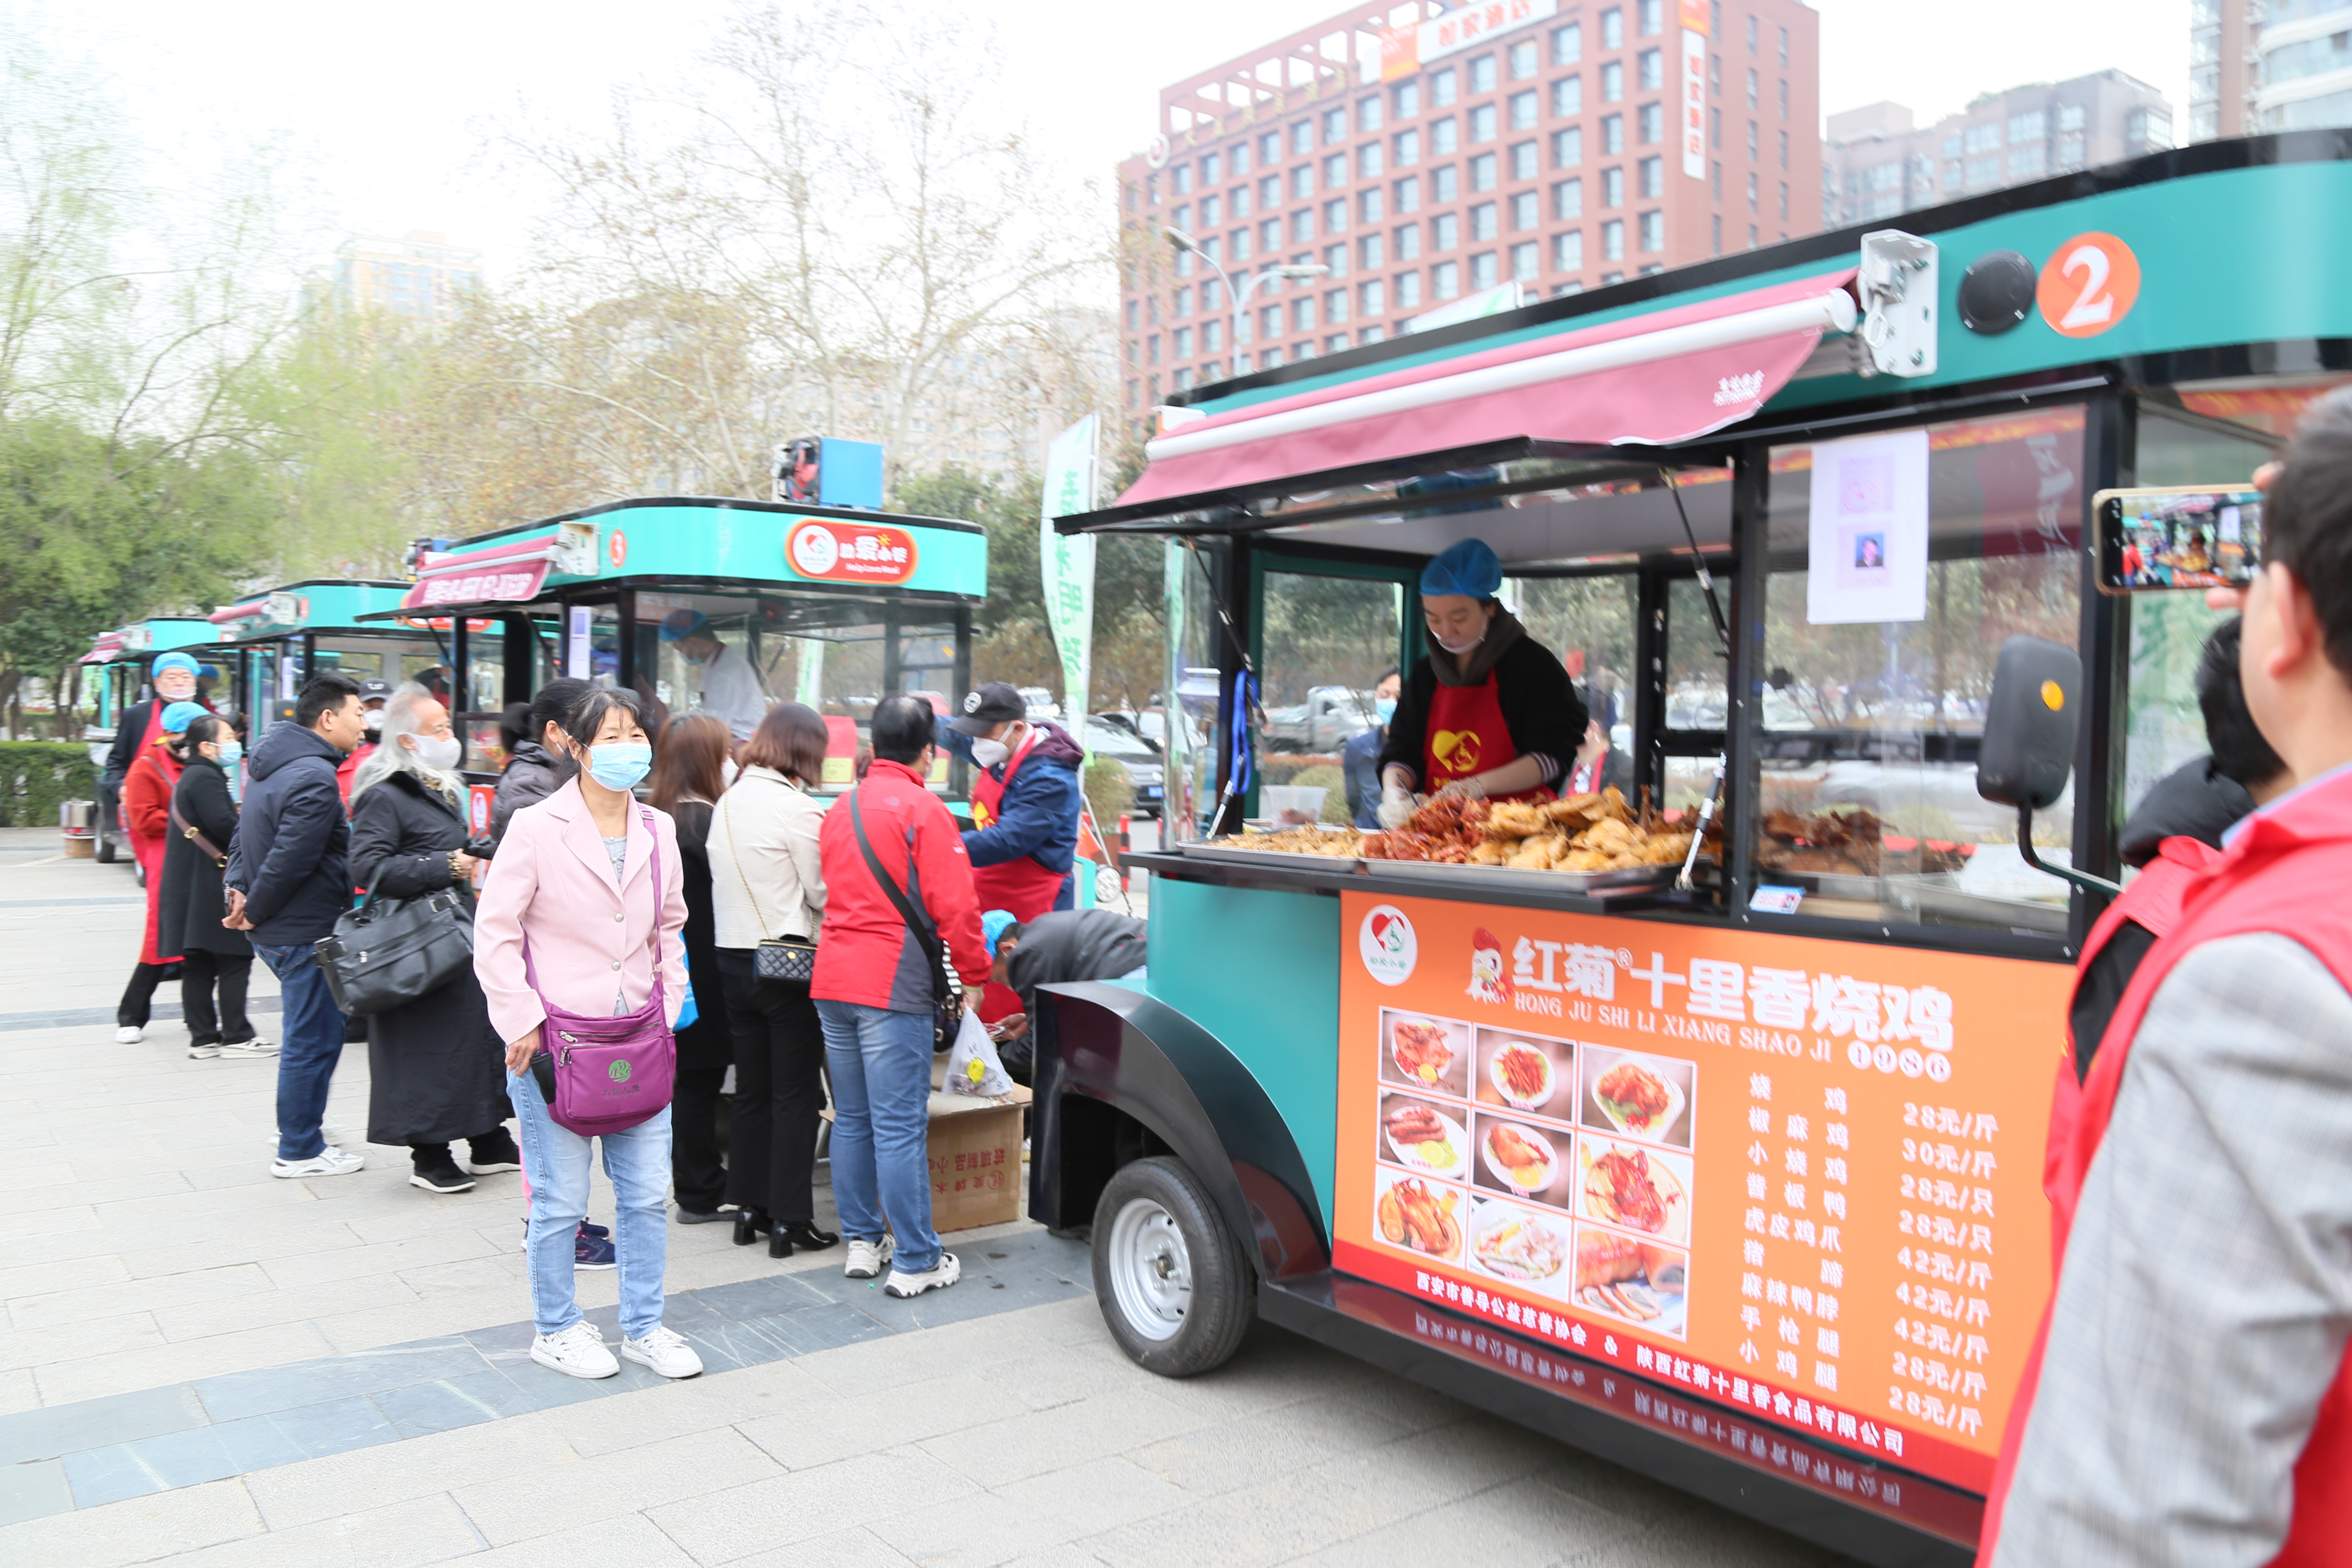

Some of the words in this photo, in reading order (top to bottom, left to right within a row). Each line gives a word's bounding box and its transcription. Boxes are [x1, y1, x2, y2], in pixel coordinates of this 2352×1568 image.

[2060, 245, 2113, 329] 2
[1515, 992, 1562, 1018] HONG
[1568, 1002, 1592, 1022] JU
[1599, 1004, 1630, 1028] SHI
[1638, 1010, 1656, 1033] LI
[1664, 1014, 1731, 1046] XIANG
[1739, 1026, 1802, 1057] SHAO
[1810, 1038, 1832, 1063] JI
[1847, 1040, 1951, 1082] 1986
[1903, 1102, 1999, 1143] 28元/斤
[1902, 1138, 1997, 1180] 30元/斤
[1900, 1174, 1994, 1218] 28元/只
[1898, 1210, 1993, 1255] 28元/只
[1897, 1246, 1993, 1291] 42元/斤
[1896, 1281, 1991, 1328] 42元/斤
[1605, 1335, 1618, 1357] &
[1894, 1317, 1989, 1365] 42元/斤
[1893, 1351, 1987, 1401] 28元/斤
[1889, 1386, 1982, 1437] 28元/斤
